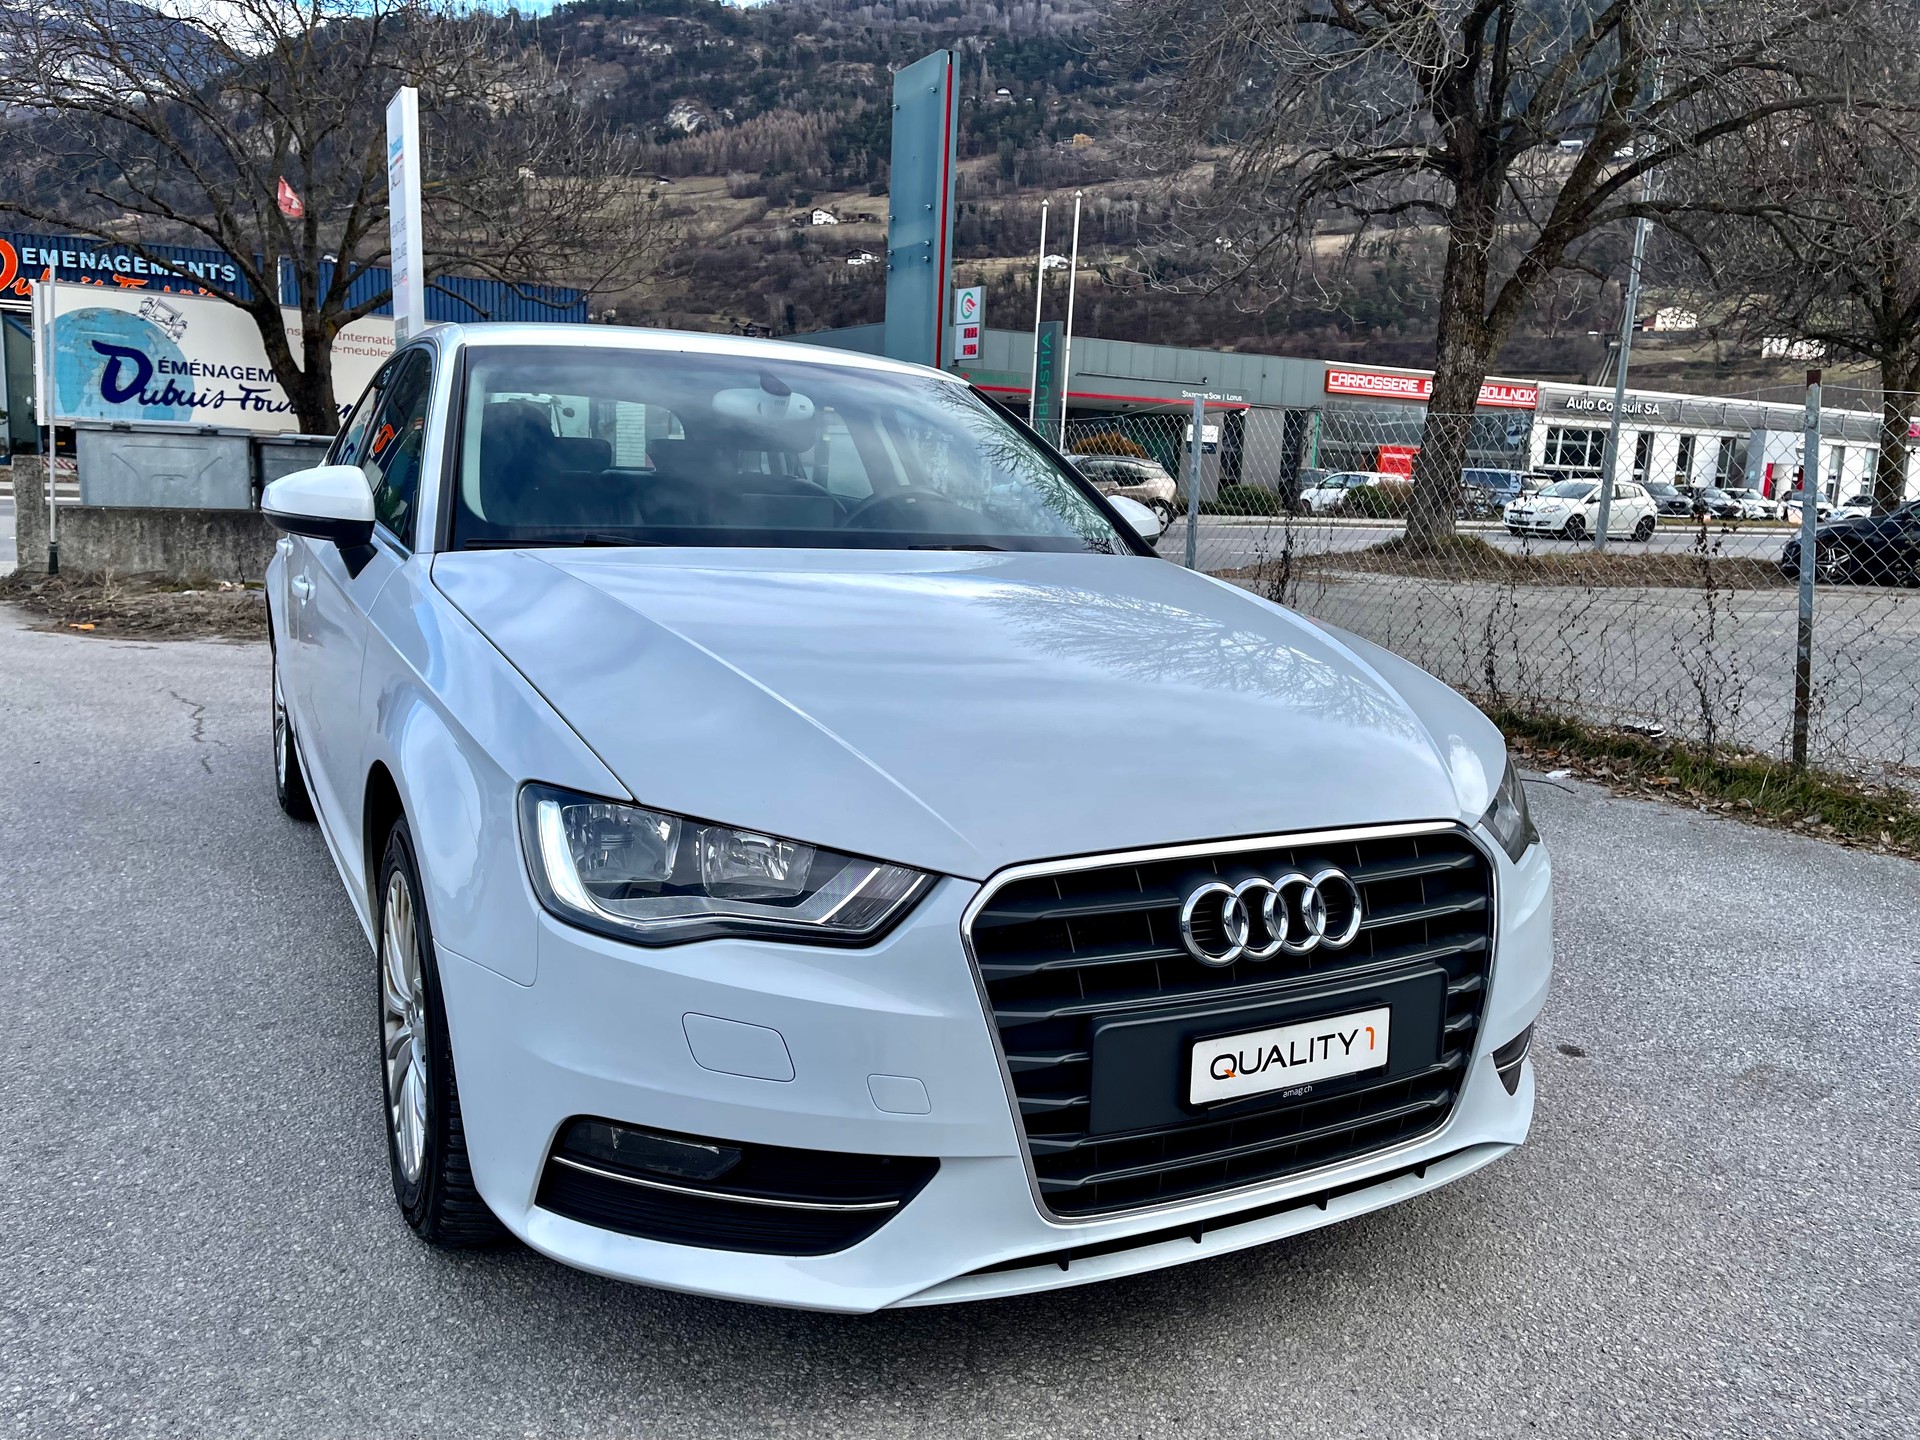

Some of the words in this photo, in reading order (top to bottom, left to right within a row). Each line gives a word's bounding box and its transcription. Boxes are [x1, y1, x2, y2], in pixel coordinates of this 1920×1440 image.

[1328, 372, 1419, 393] CARROSSERIE
[1478, 385, 1537, 402] BOULNOIX
[1566, 396, 1595, 411] Auto
[1597, 398, 1642, 414] Cosult
[1644, 402, 1660, 416] SA
[1282, 1085, 1313, 1098] amag.ch
